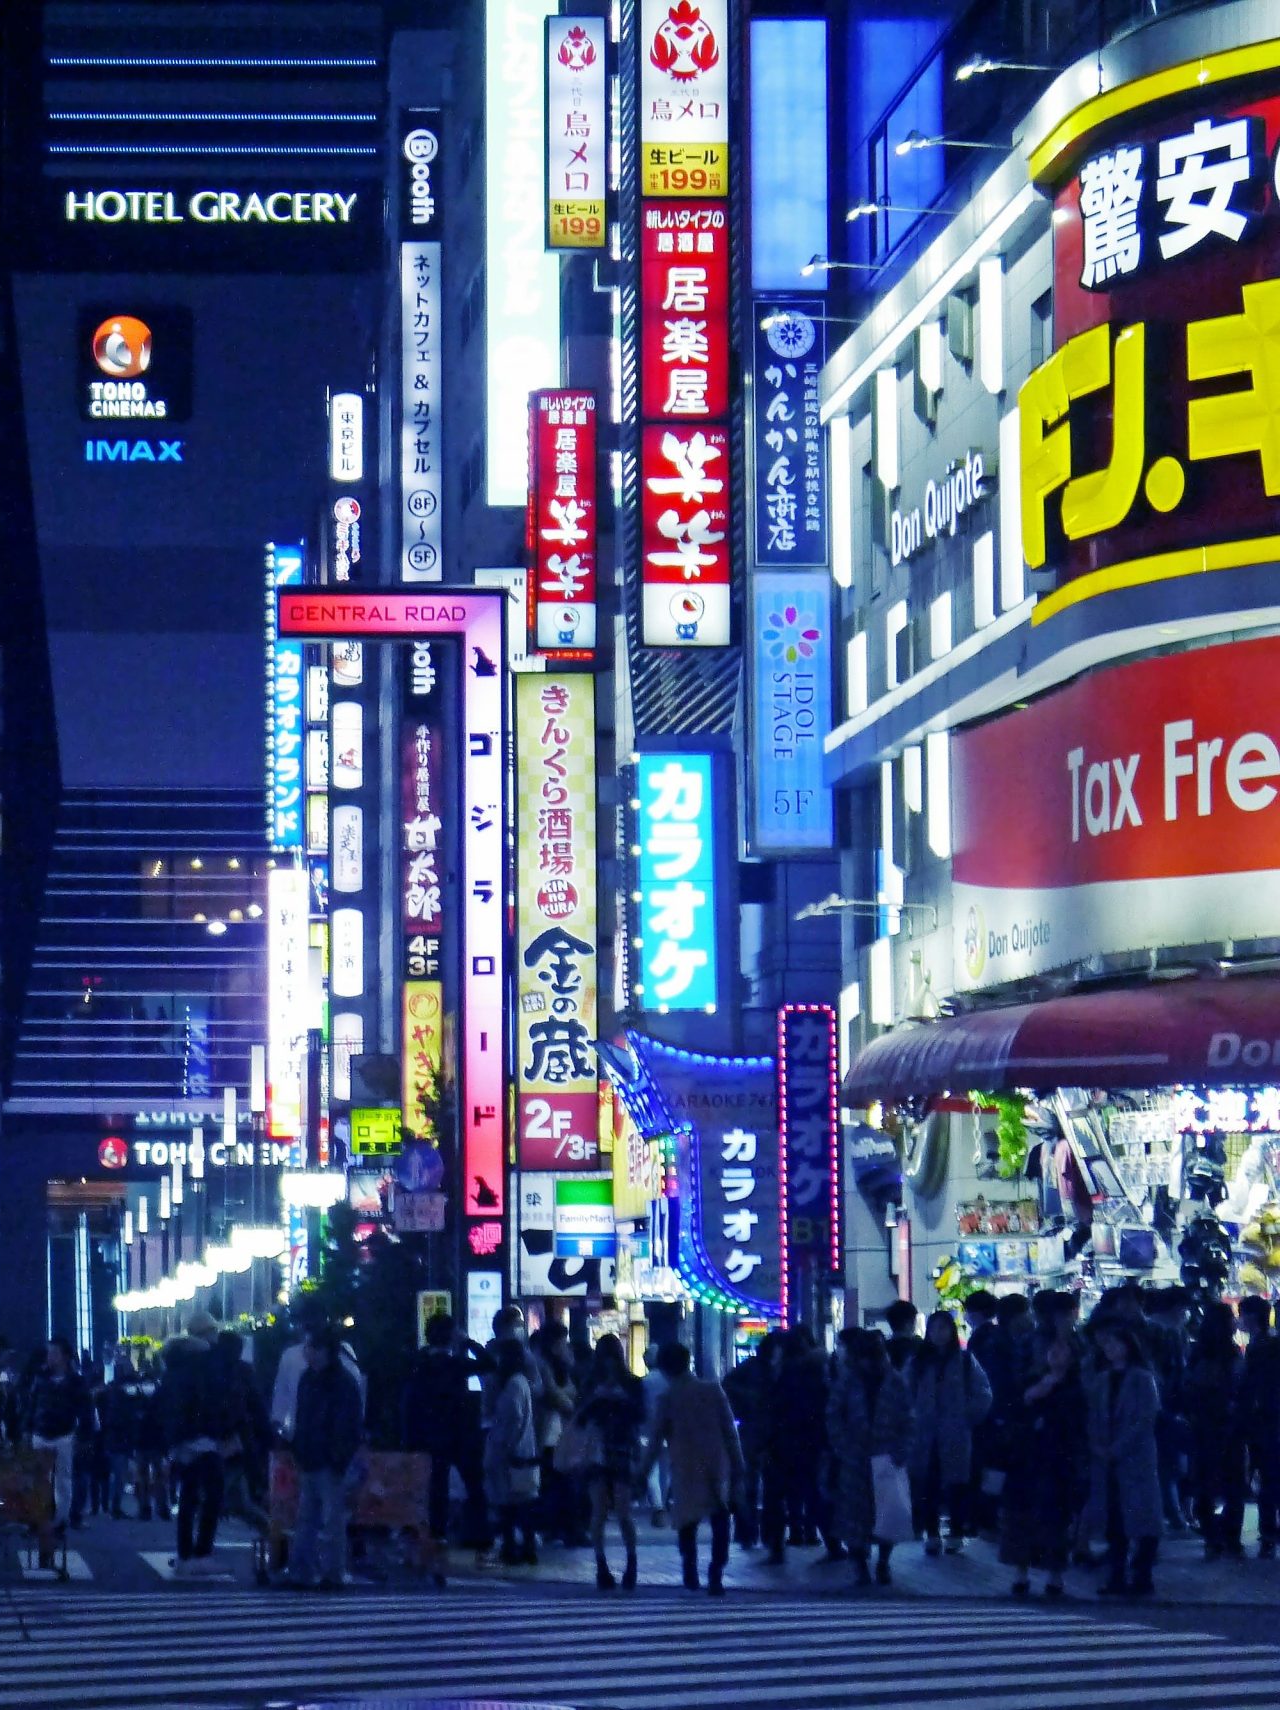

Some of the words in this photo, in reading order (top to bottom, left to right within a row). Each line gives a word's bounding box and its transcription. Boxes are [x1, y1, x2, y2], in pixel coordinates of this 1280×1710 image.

[650, 99, 720, 120] 鳥メロ
[564, 111, 591, 192] 鳥メロ
[650, 149, 719, 165] 生ビール
[661, 169, 707, 190] 199
[66, 191, 184, 223] HOTEL
[191, 191, 358, 224] GRACERY
[553, 204, 600, 216] 生ビール
[646, 210, 725, 230] 新しいタイプの
[1079, 119, 1280, 289] 驚安
[559, 217, 601, 237] 199
[657, 233, 714, 253] 居酒屋
[662, 267, 711, 414] 居楽屋
[90, 382, 146, 401] TOHO
[91, 401, 167, 417] CINEMAS
[85, 440, 184, 462] IMAX
[339, 410, 356, 472] 東京ビル
[764, 363, 798, 551] かんかん商店
[555, 428, 579, 497] 居楽屋
[413, 497, 431, 511] 8F
[892, 505, 920, 567] Don
[924, 453, 983, 538] Quijote
[413, 551, 431, 564] 5F
[290, 606, 397, 622] CENTRAL
[406, 606, 467, 622] ROAD
[772, 672, 795, 760] STAGE
[793, 672, 815, 744] IDOL
[274, 650, 302, 838] カラオケランド
[537, 685, 573, 875] きんくら酒場
[1066, 746, 1143, 843] Tax
[774, 788, 814, 815] 5F
[404, 813, 443, 922] 甘太郎
[646, 762, 709, 1001] カラオケ
[539, 902, 577, 918] KURA
[408, 936, 440, 955] 4F
[469, 730, 501, 1127] ゴジラロード
[987, 928, 1009, 957] Don
[1011, 917, 1052, 956] Quijote
[408, 957, 440, 976] 3F
[523, 926, 596, 1084] 金の蔵
[524, 1099, 573, 1139] 2F
[559, 1214, 612, 1225] FamilyMart
[720, 1128, 762, 1284] カラオケ
